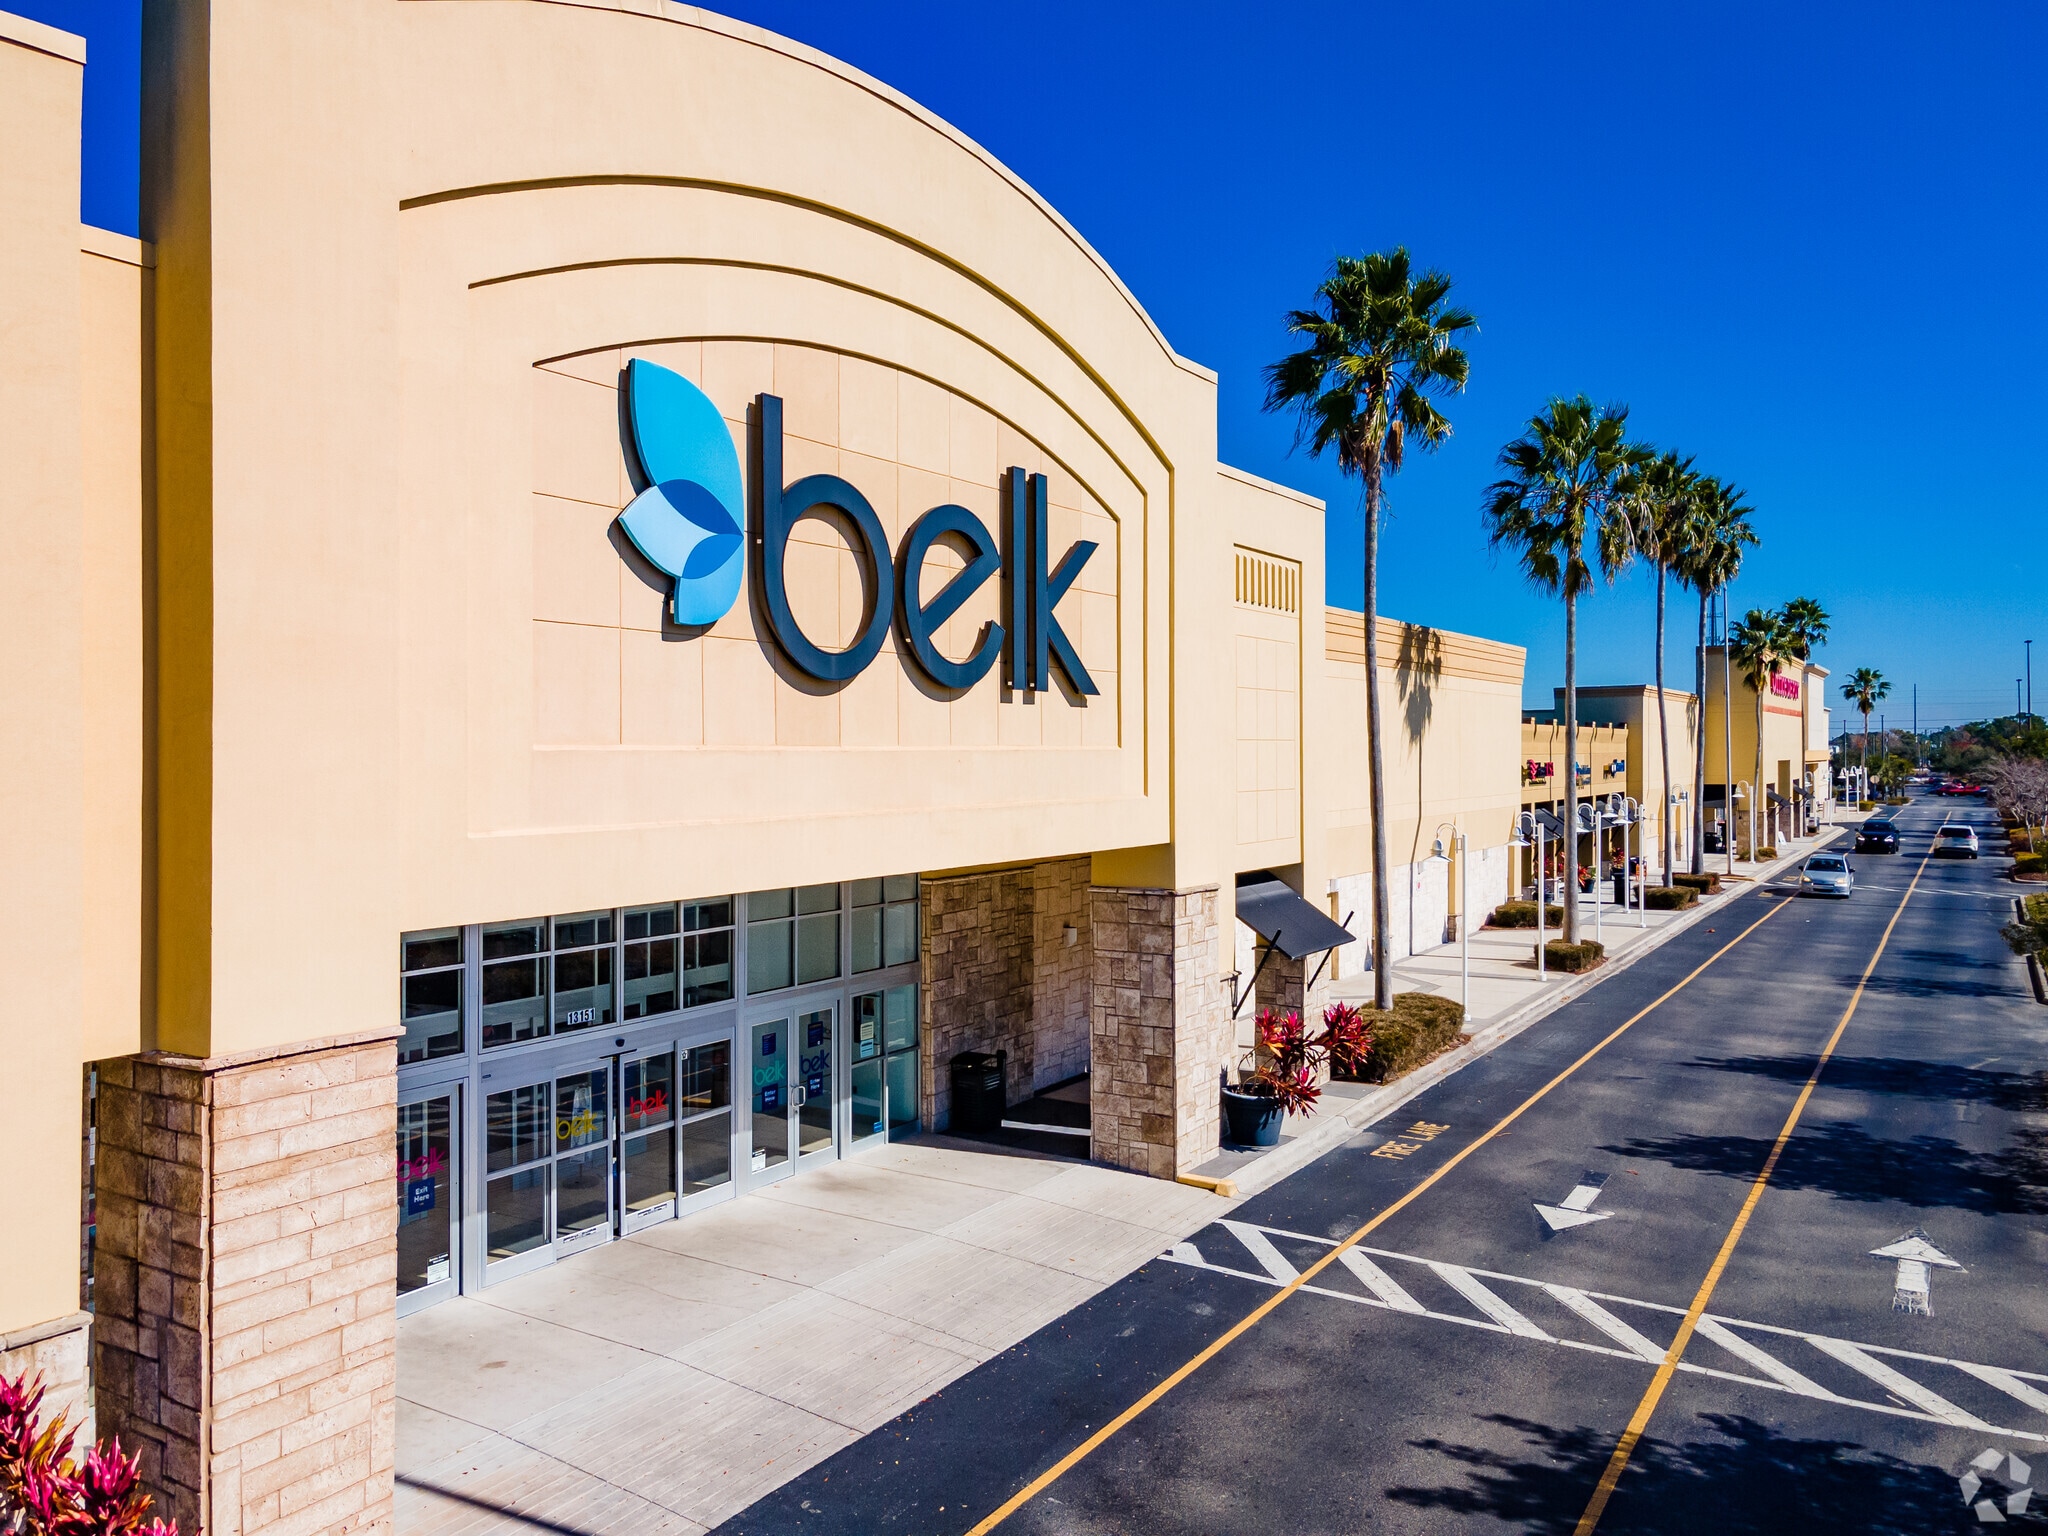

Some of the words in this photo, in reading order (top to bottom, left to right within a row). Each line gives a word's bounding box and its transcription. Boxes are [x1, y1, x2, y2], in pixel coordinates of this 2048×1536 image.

[756, 392, 1101, 696] belk
[568, 1008, 595, 1024] 13151
[754, 1060, 785, 1086] belk
[800, 1050, 830, 1075] belk
[630, 1090, 669, 1119] belk
[556, 1109, 598, 1140] belk
[1370, 1140, 1423, 1160] FIRE
[1398, 1121, 1451, 1141] LANE
[396, 1147, 445, 1182] belk
[413, 1194, 430, 1203] Here
[415, 1185, 428, 1196] Exit
